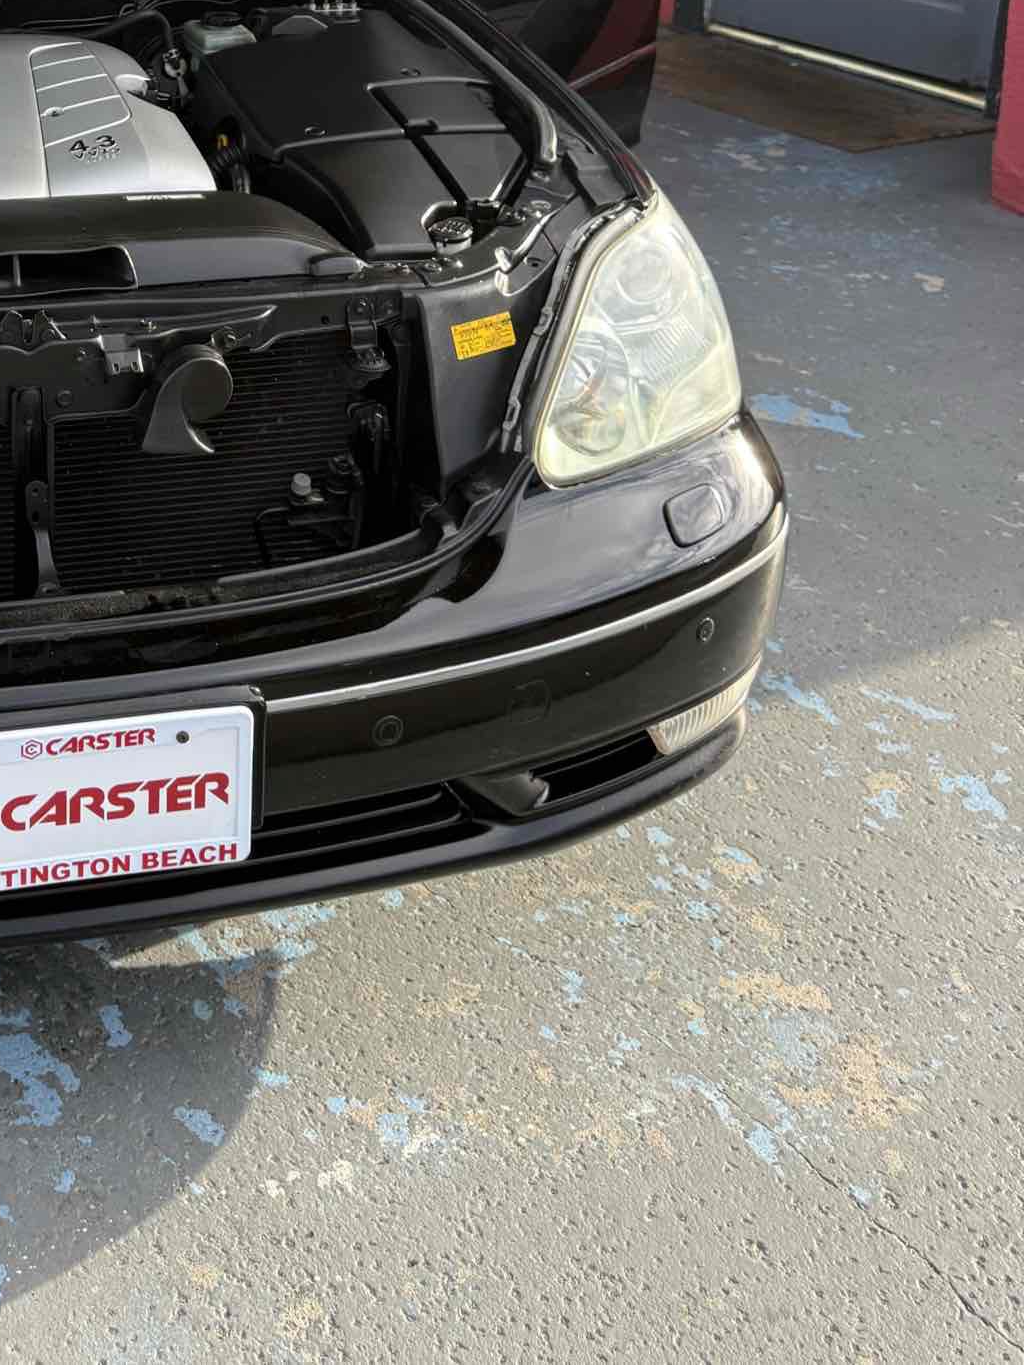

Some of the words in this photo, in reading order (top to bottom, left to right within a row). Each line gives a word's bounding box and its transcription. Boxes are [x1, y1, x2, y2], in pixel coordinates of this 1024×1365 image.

[46, 728, 156, 756] CARSTER
[1, 772, 230, 831] CARSTER
[142, 843, 238, 870] BEACH
